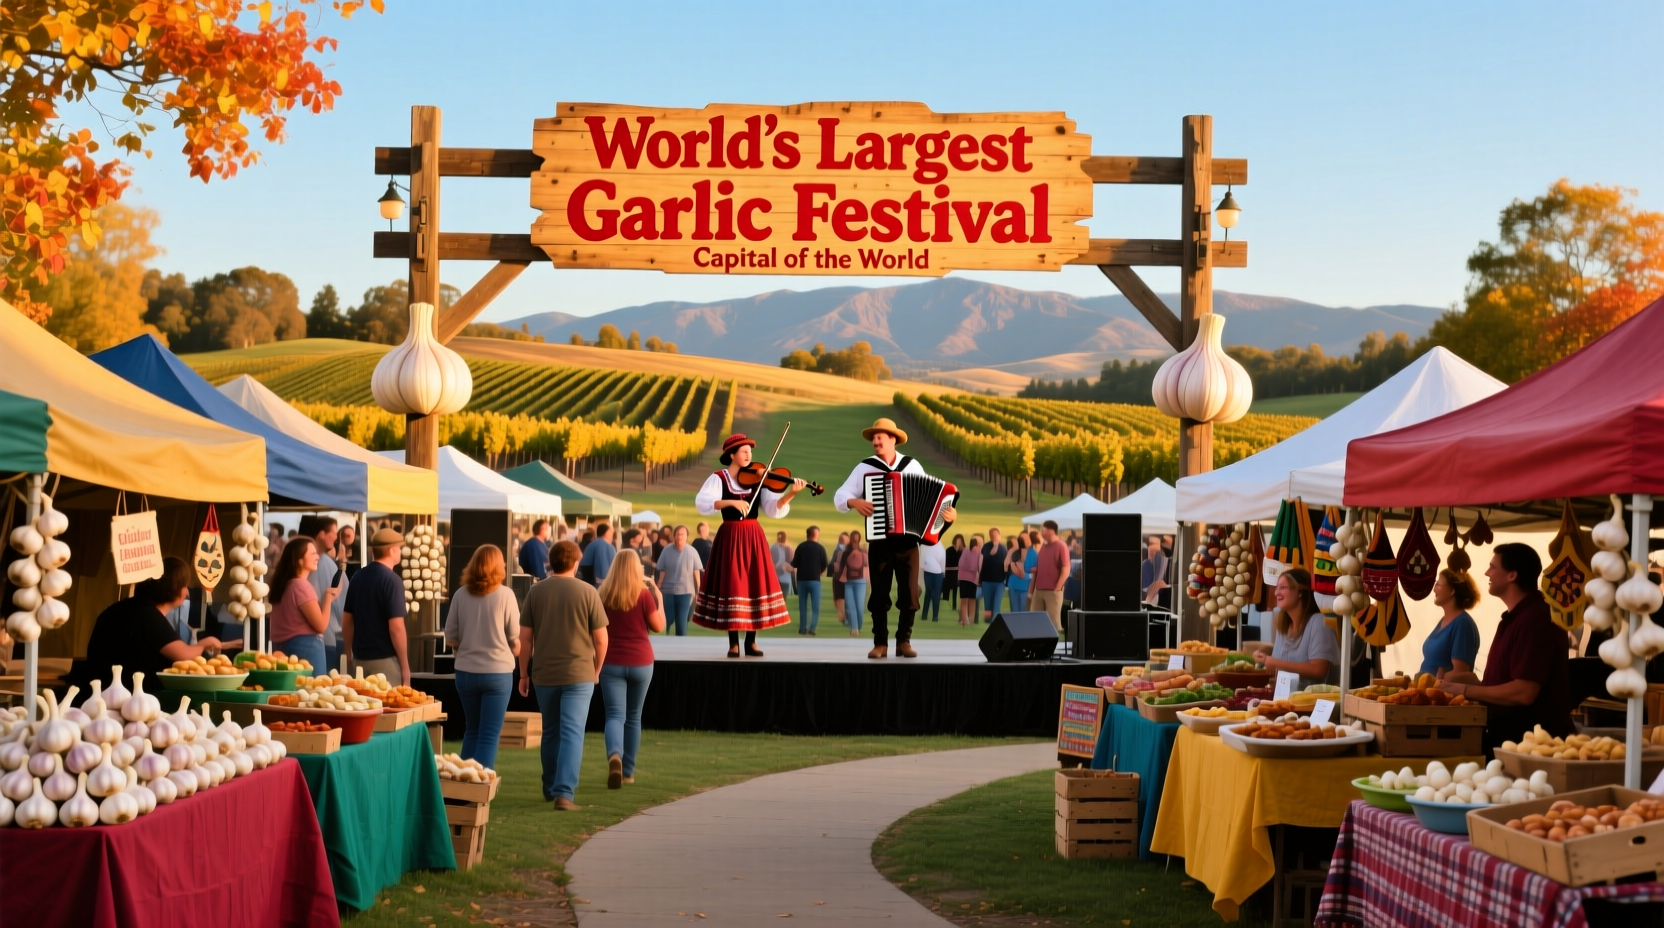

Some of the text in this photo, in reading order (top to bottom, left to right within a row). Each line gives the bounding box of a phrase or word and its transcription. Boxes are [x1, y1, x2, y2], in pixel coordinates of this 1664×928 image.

[585, 113, 1034, 185] World's Largest
[566, 179, 1053, 244] Garlic Festival
[693, 246, 930, 274] Capital of the World
